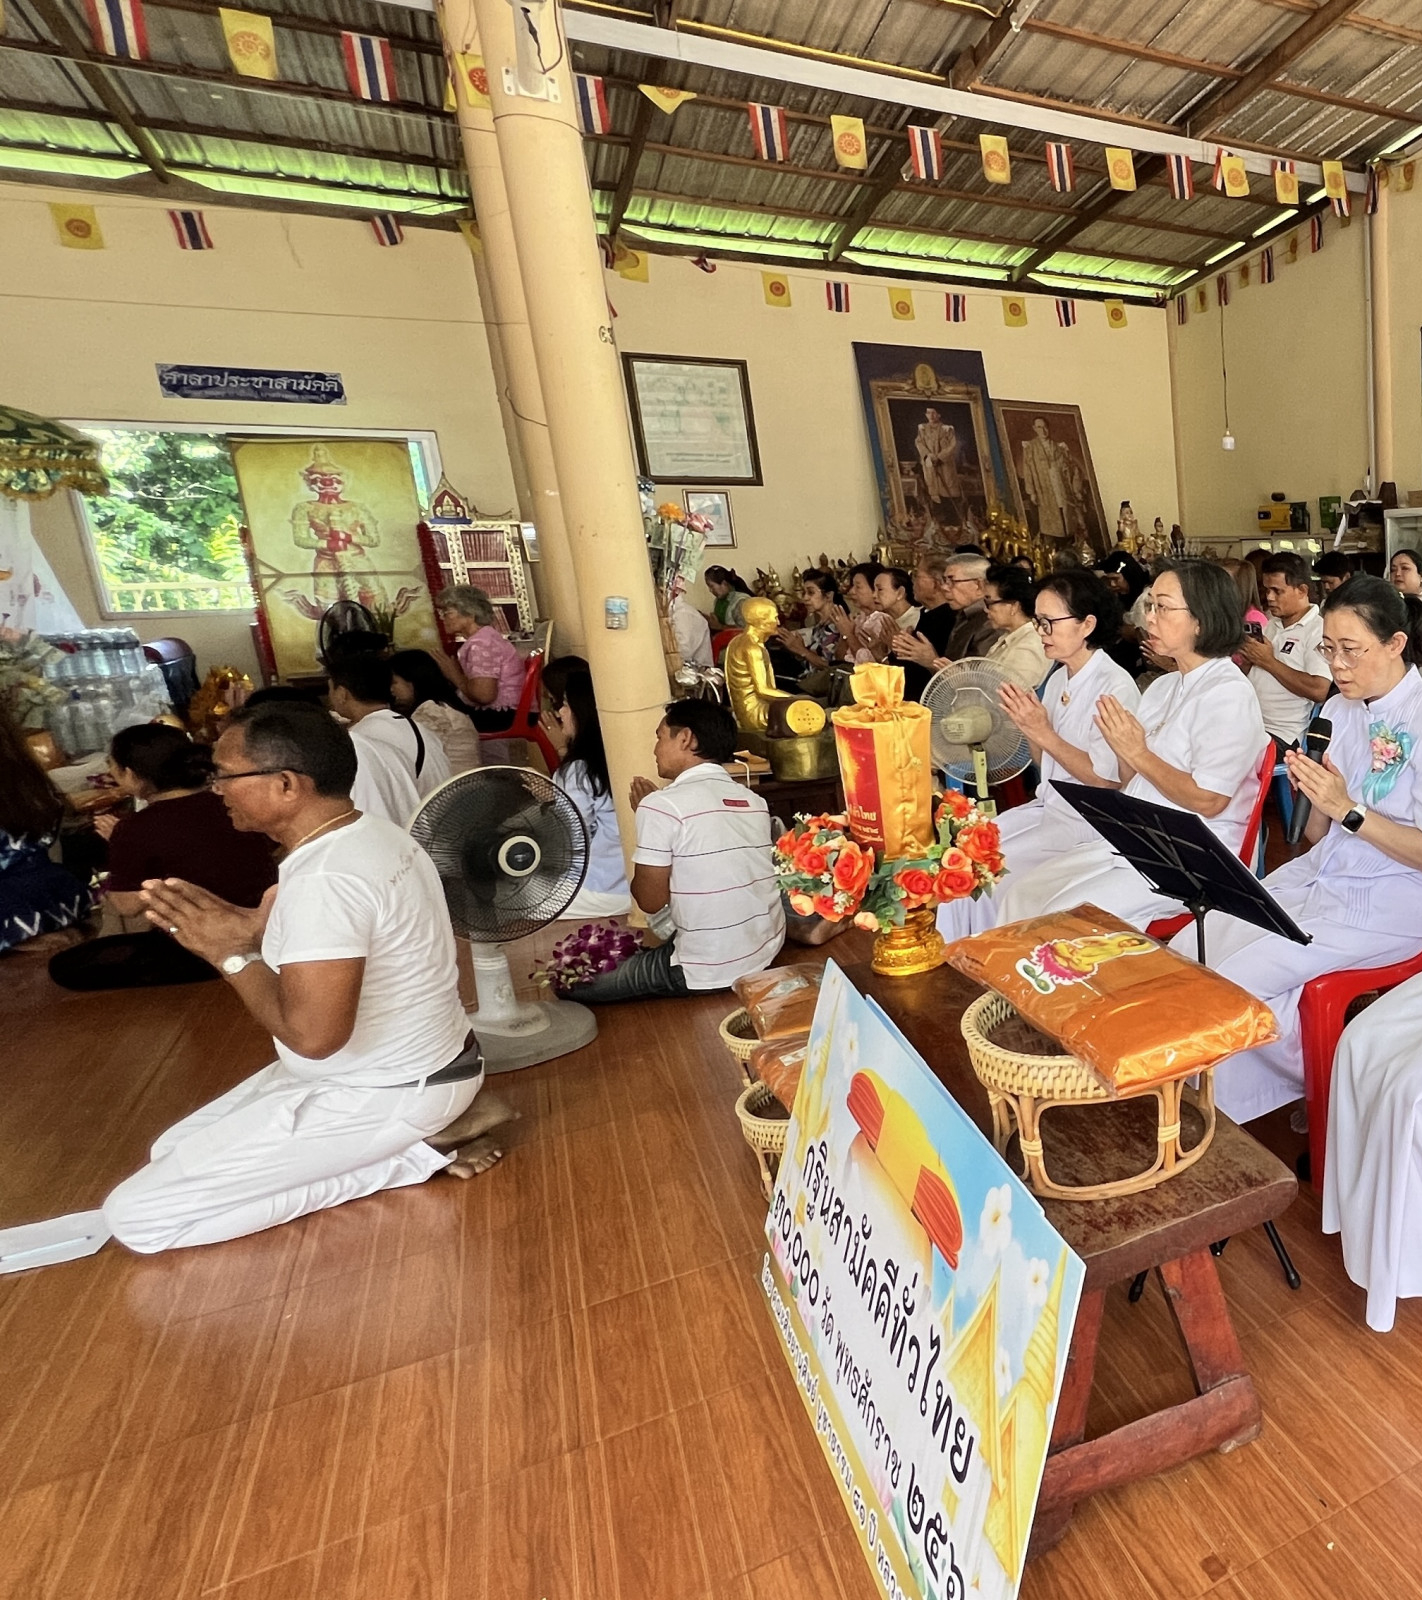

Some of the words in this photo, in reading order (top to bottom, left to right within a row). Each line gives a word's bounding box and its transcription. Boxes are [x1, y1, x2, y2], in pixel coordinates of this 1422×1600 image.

[162, 371, 339, 392] ศาลาประชาสามัคคี
[762, 1252, 774, 1297] โดย
[868, 1511, 877, 1549] ปี
[774, 1189, 819, 1306] ๓๐,๐๐๐
[821, 1286, 834, 1345] วัด
[836, 1330, 901, 1489] พุทธศักราช
[803, 1140, 974, 1483] กฐินสามัคคีทั่วไทย
